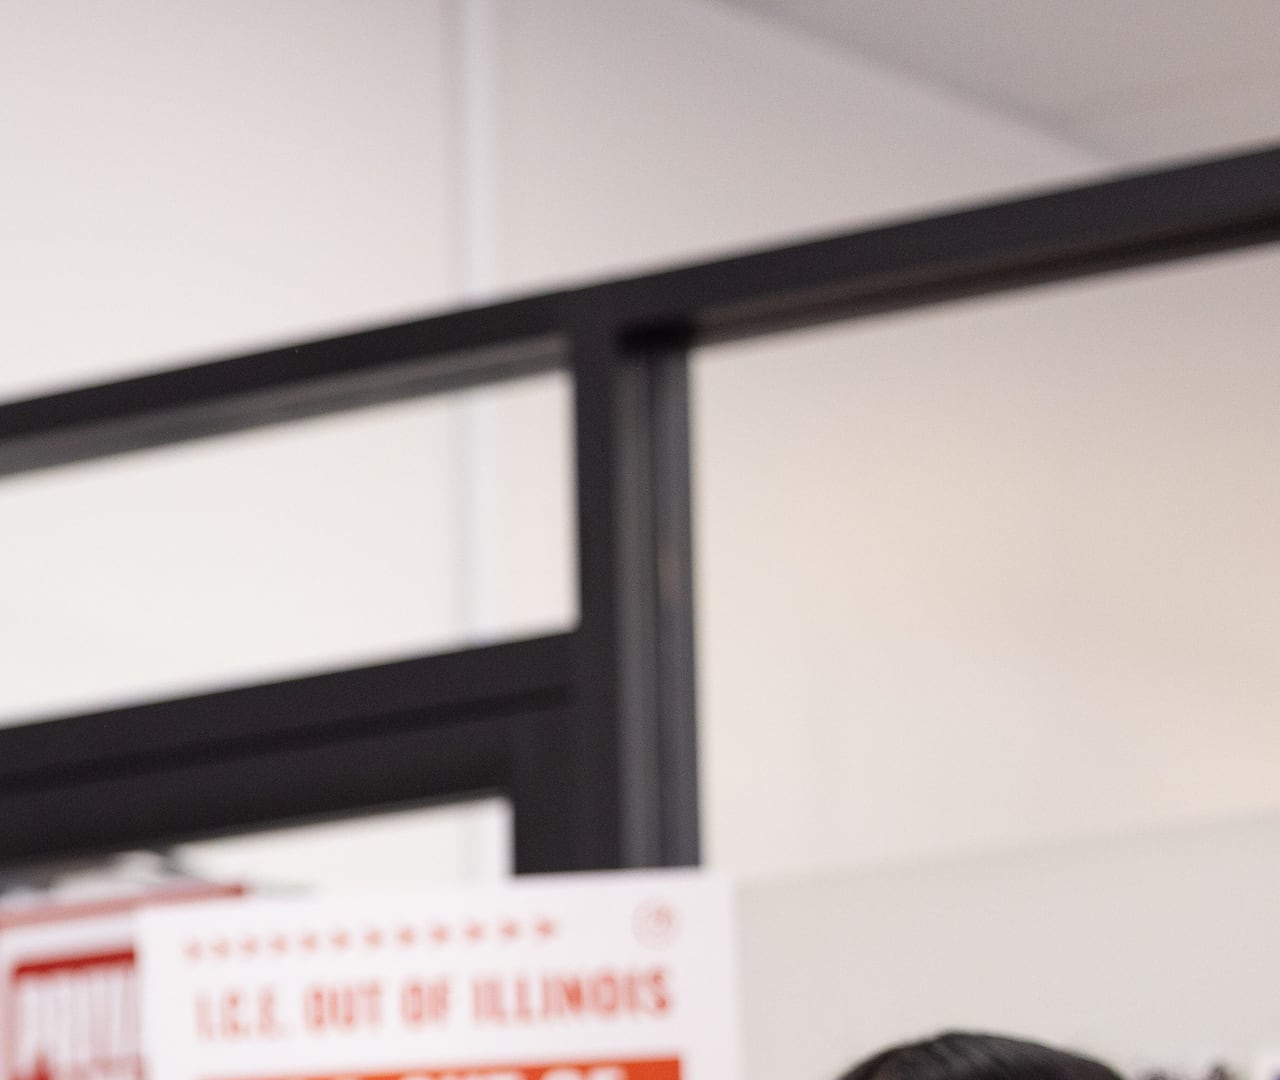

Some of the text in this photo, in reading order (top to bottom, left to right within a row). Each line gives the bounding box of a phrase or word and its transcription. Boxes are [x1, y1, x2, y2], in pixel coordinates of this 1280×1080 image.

[301, 978, 383, 1034] OUT
[399, 974, 450, 1030] OF
[471, 966, 672, 1024] ILLINOIS
